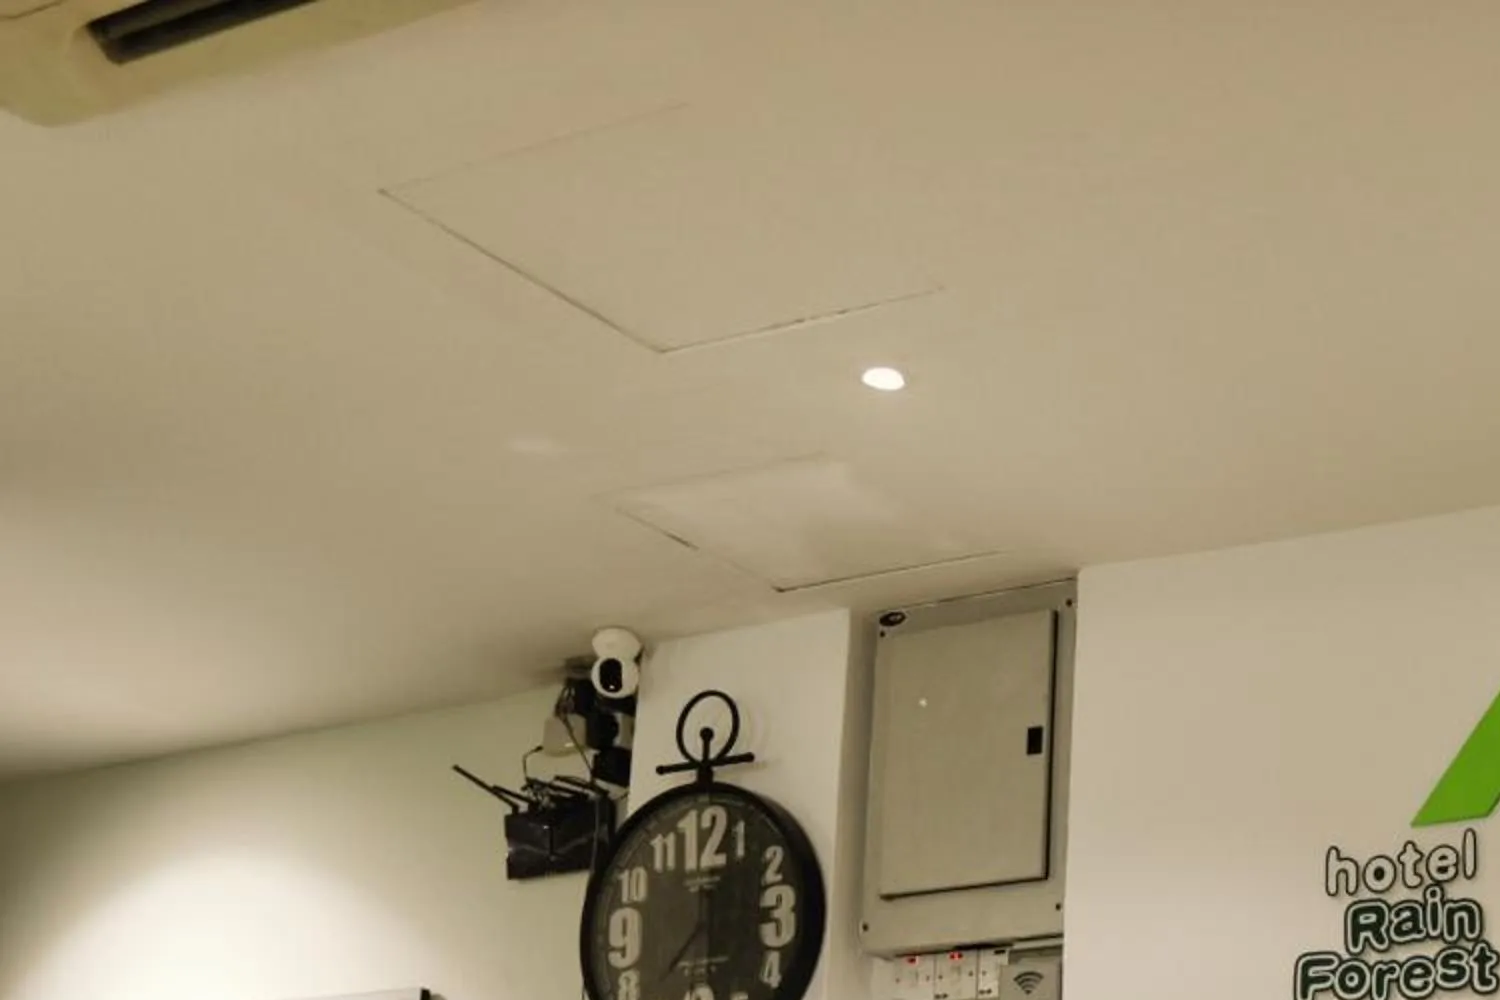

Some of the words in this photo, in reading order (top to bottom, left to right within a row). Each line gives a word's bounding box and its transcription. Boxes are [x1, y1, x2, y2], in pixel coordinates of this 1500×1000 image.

[650, 832, 676, 873] 11
[678, 805, 728, 873] 12
[734, 820, 745, 859] 1
[1325, 828, 1477, 897] hotel
[619, 866, 648, 904] 10
[762, 845, 785, 886] 2
[608, 907, 642, 969] 9
[759, 884, 796, 948] 3
[1344, 884, 1484, 955] Rain
[760, 950, 782, 989] 4
